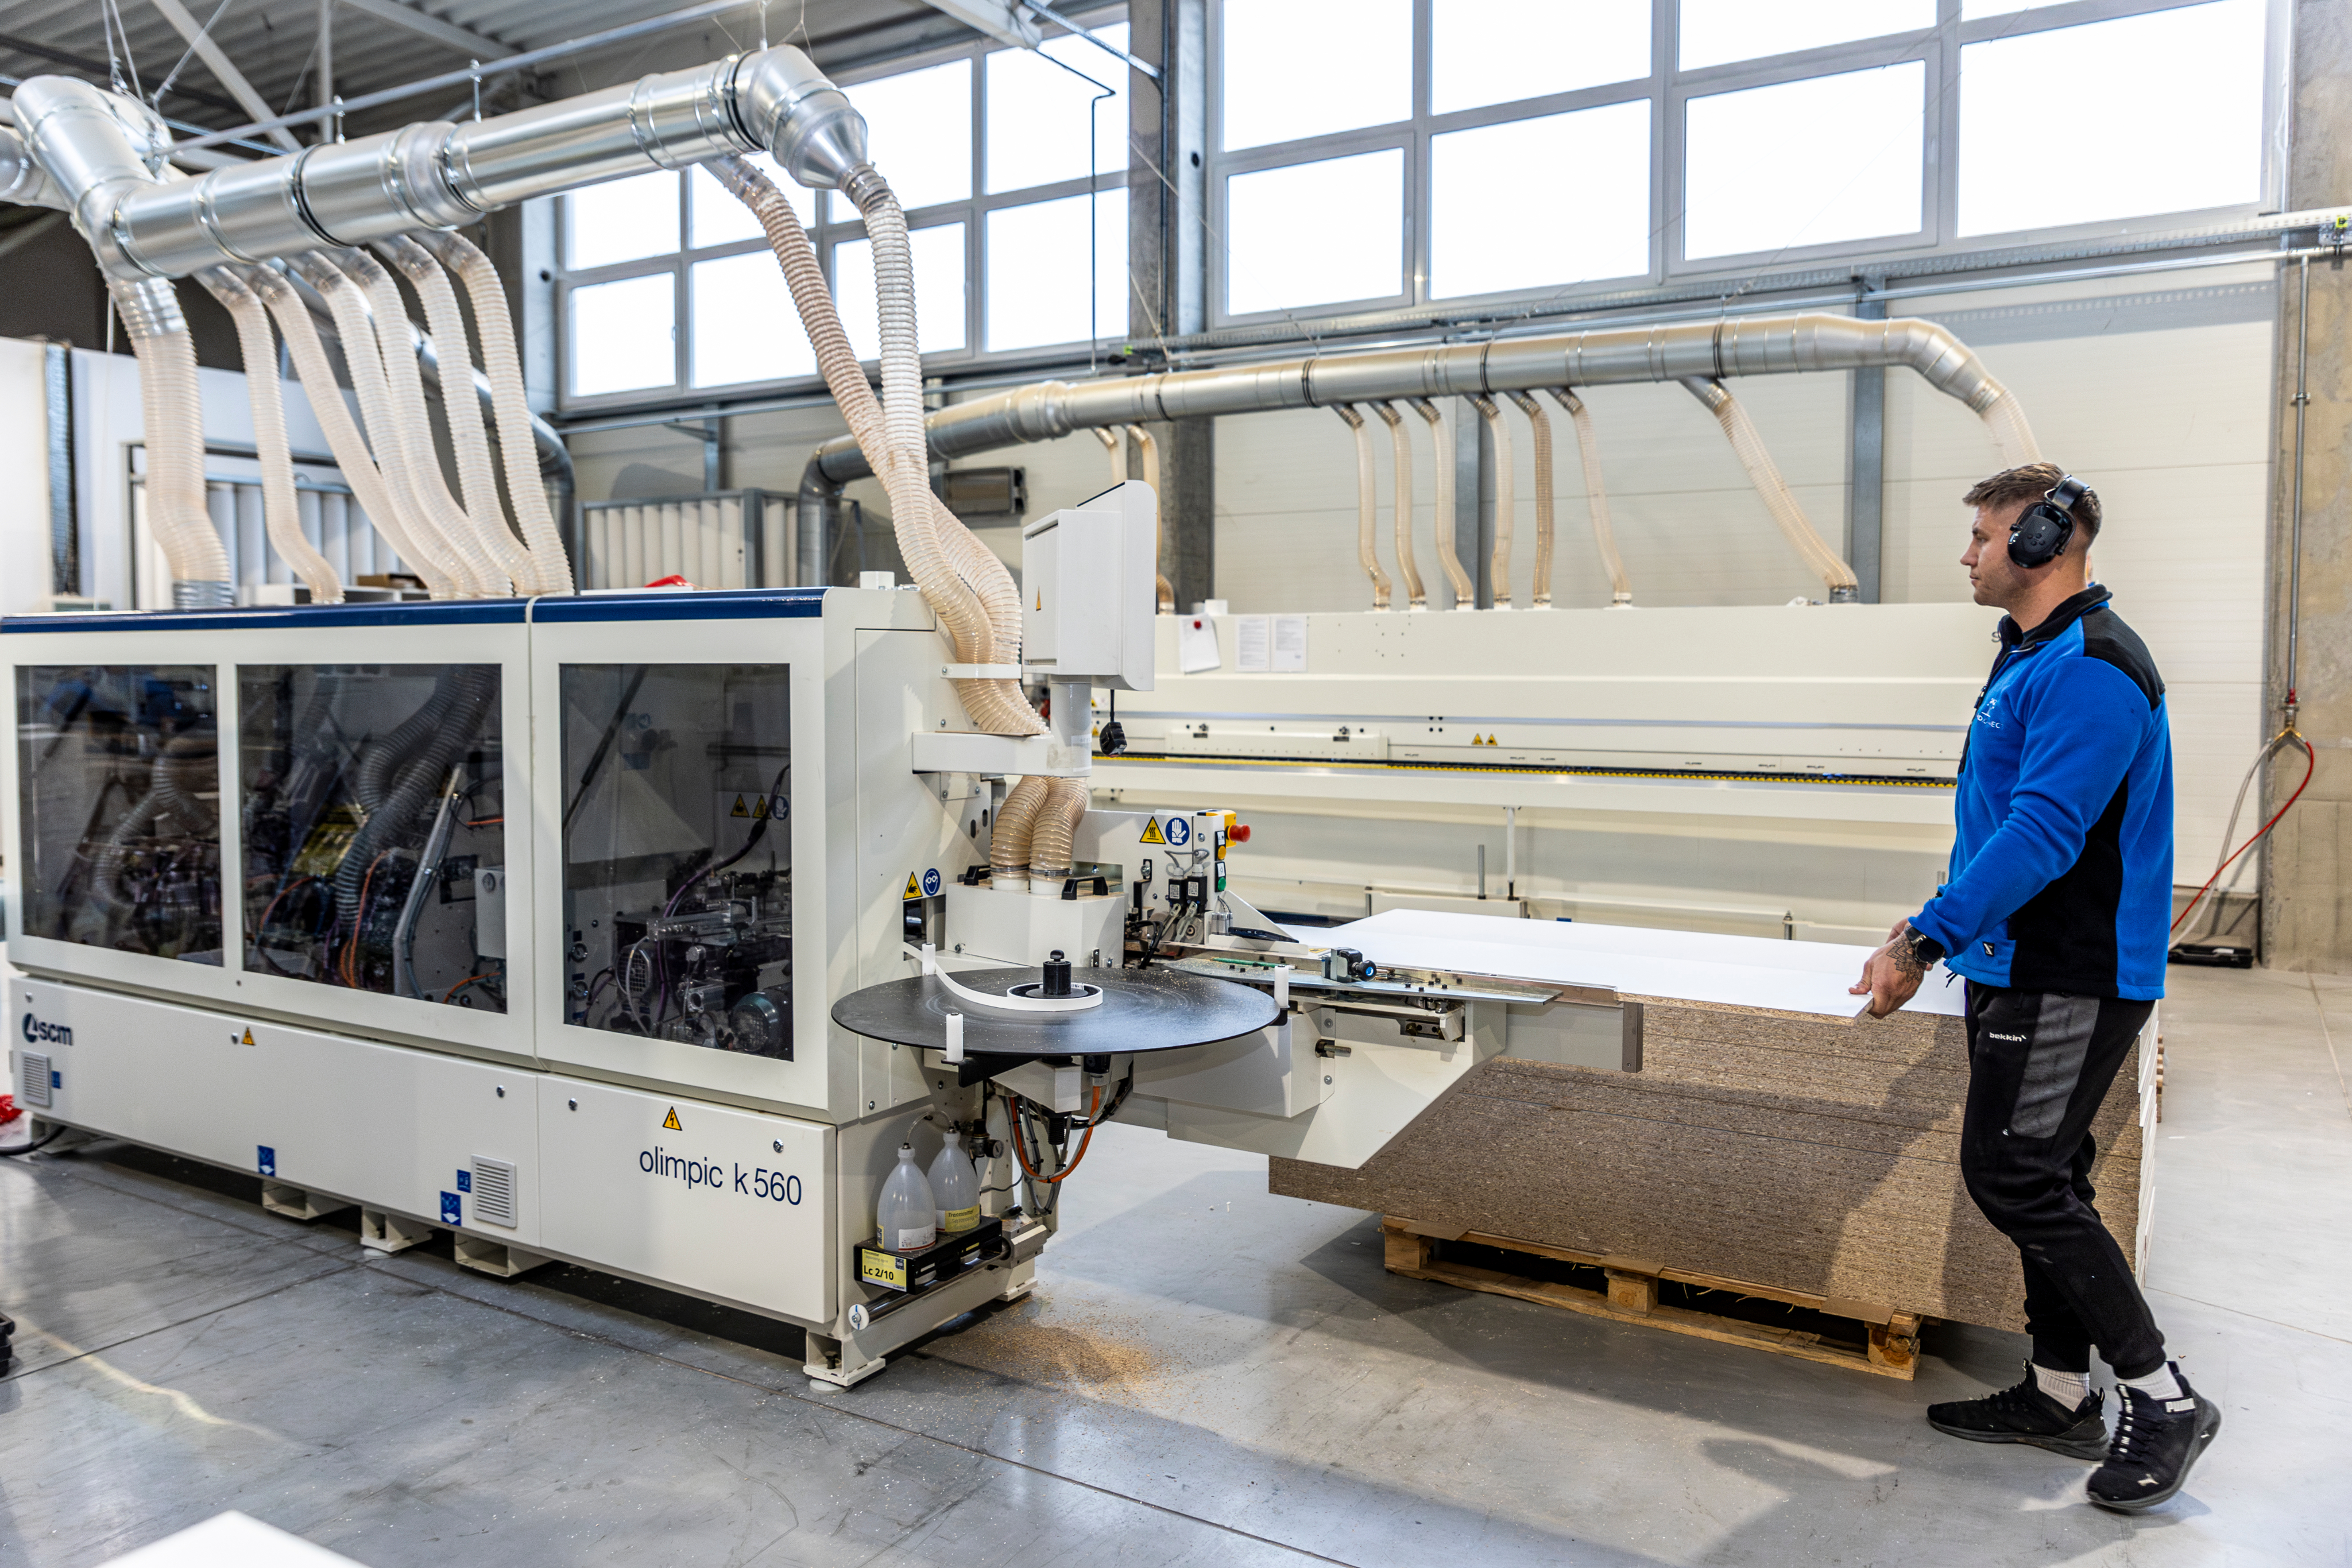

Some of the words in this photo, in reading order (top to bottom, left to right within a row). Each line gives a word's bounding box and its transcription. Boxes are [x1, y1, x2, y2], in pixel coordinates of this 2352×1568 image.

[38, 1021, 73, 1046] scm
[639, 1145, 724, 1190] olimpic
[734, 1162, 749, 1195] k
[753, 1167, 802, 1206] 560
[864, 1265, 873, 1275] Lc
[875, 1268, 894, 1281] 2/10
